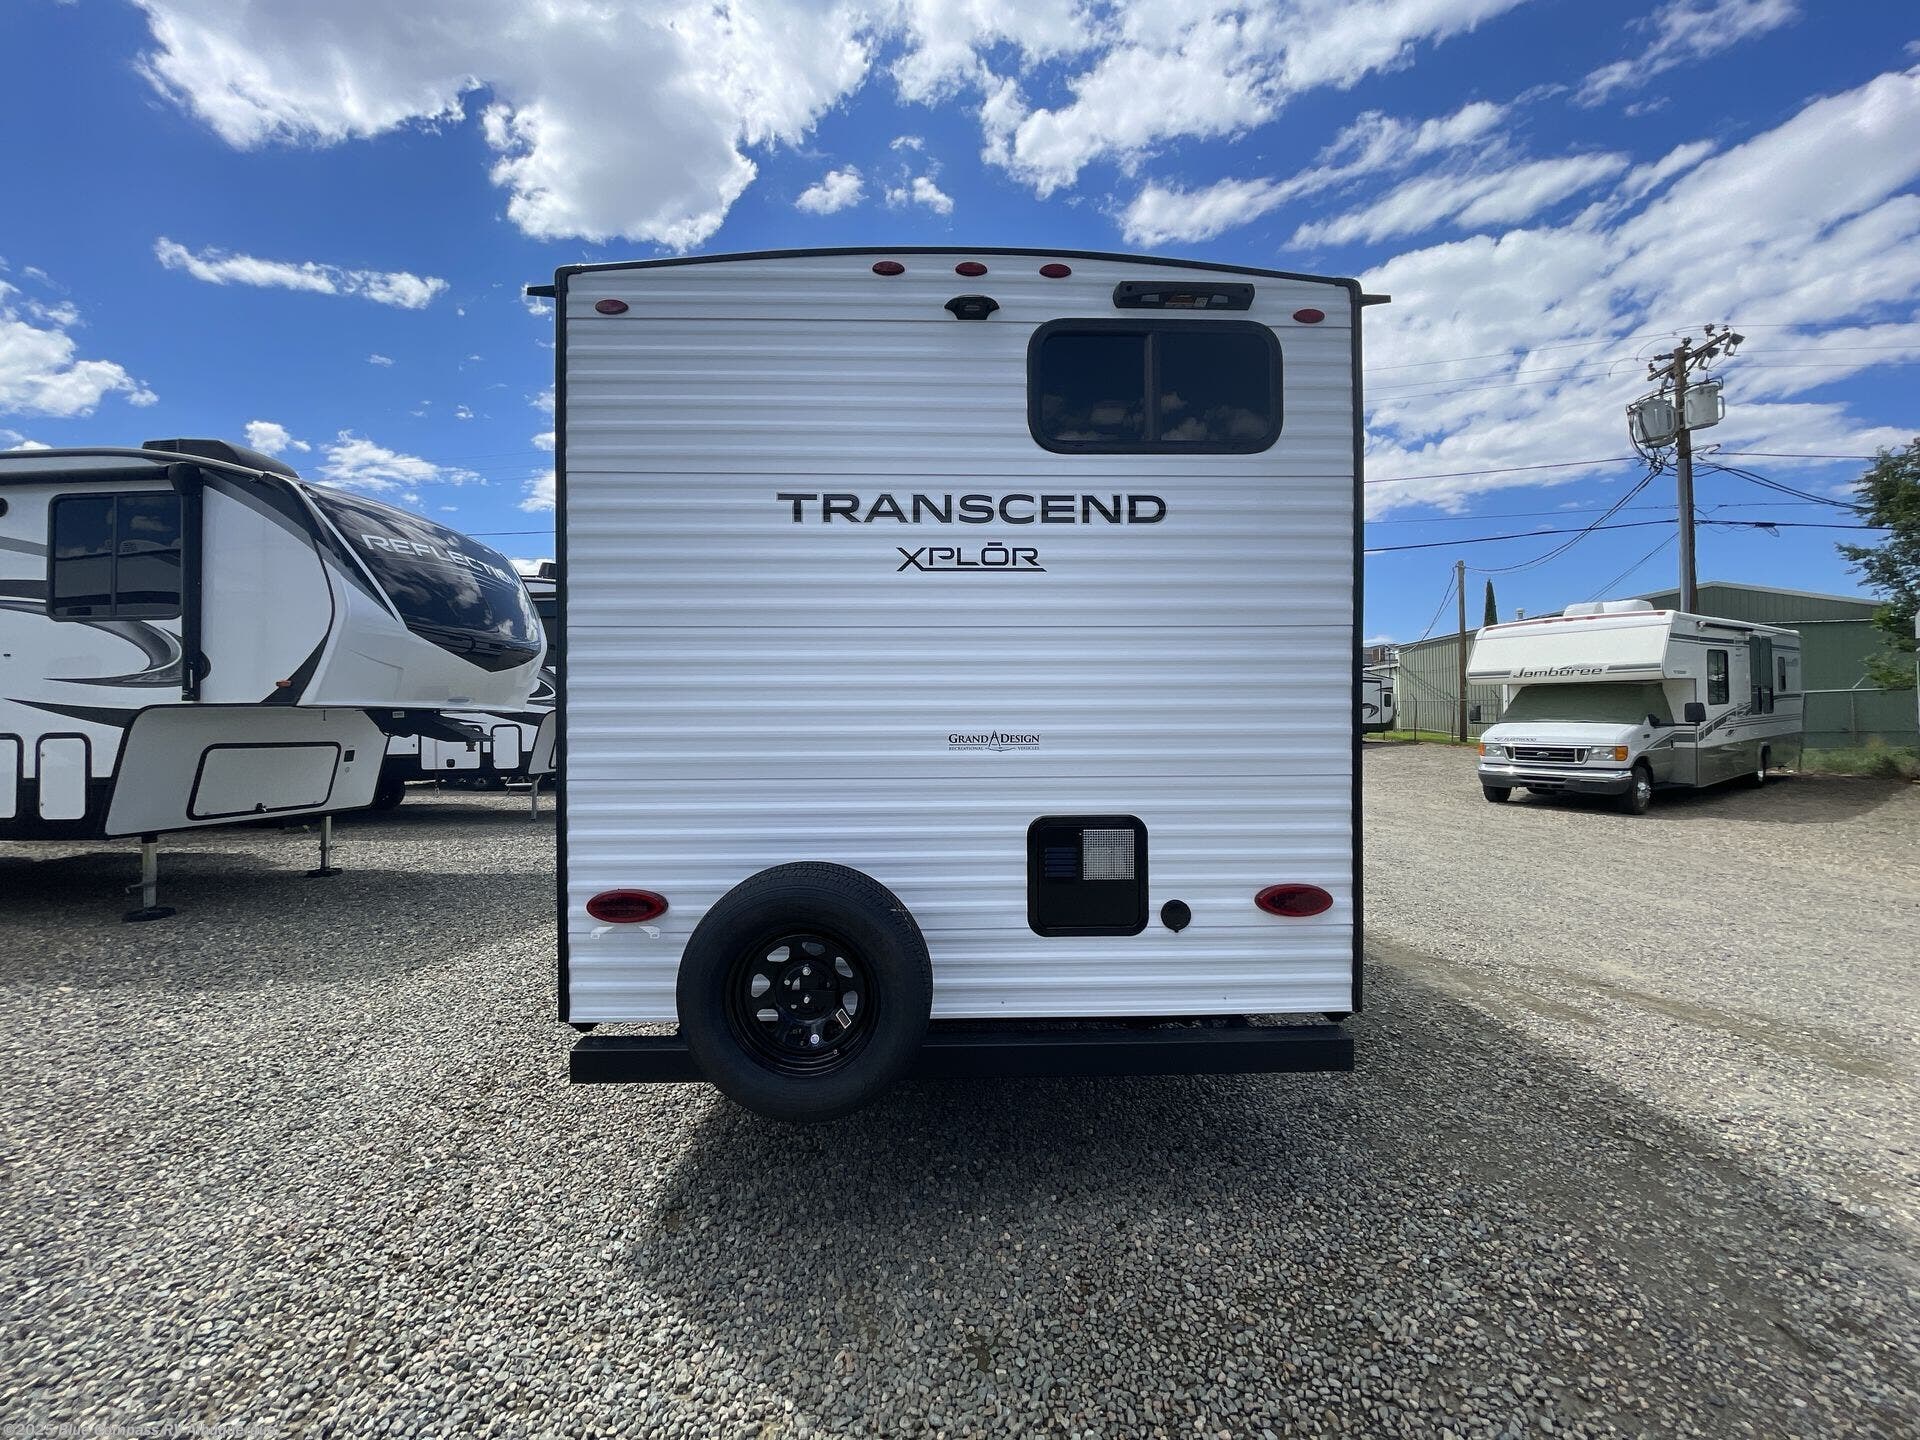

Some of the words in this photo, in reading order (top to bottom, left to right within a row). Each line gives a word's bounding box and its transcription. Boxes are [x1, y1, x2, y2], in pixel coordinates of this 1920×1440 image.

[776, 492, 1168, 524] TRANSCEND
[1513, 667, 1603, 678] Jamboree
[1001, 733, 1040, 743] DESIGN
